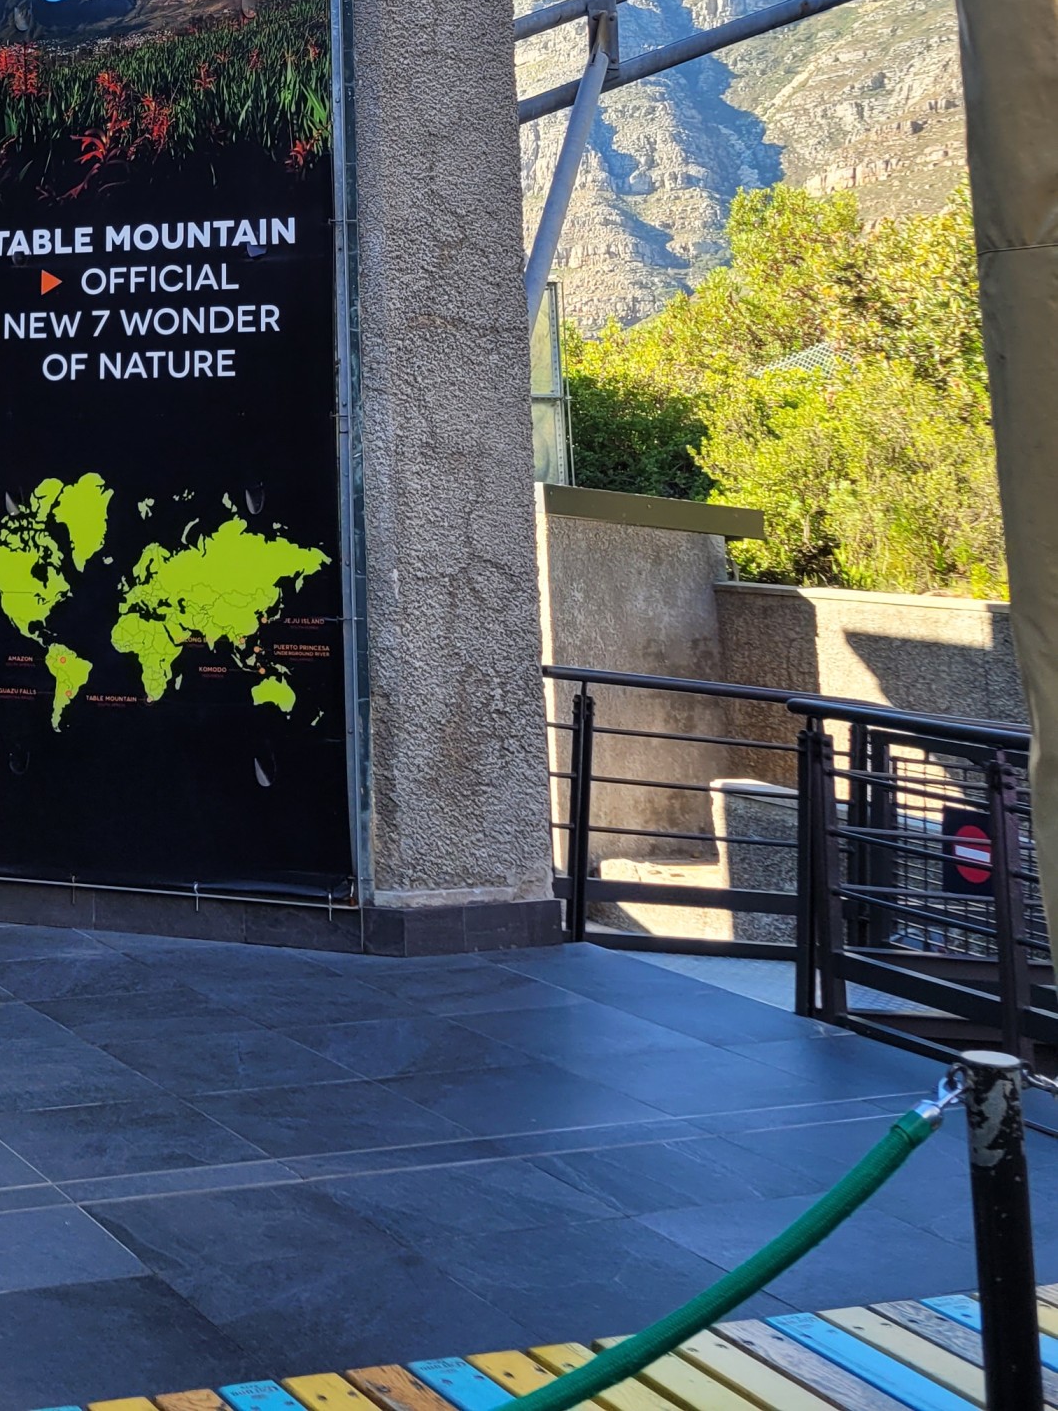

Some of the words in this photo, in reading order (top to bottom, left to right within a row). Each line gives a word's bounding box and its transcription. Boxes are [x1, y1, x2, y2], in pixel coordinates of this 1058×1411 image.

[105, 217, 296, 252] MOUNTAIN
[81, 263, 240, 296] OFFICIAL
[3, 310, 82, 339] NEW
[91, 309, 111, 337] 7
[119, 305, 281, 337] WONDER
[42, 352, 88, 381] OF
[99, 349, 237, 380] NATURE
